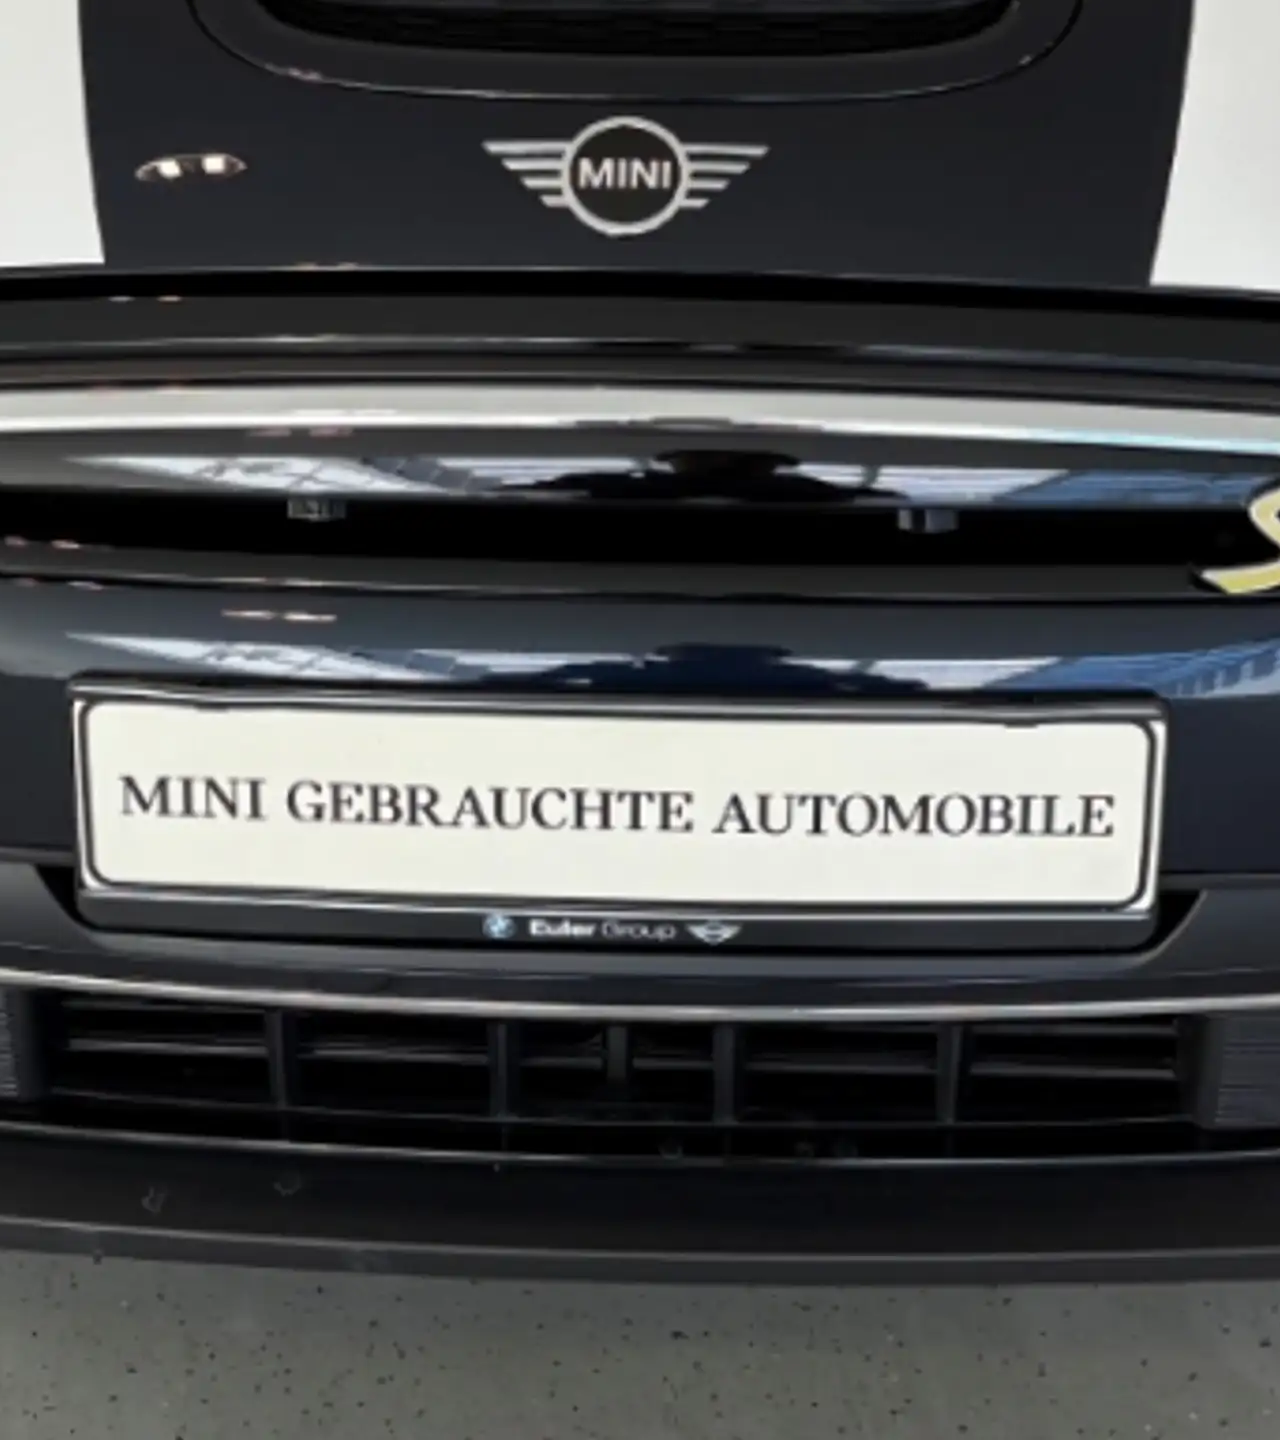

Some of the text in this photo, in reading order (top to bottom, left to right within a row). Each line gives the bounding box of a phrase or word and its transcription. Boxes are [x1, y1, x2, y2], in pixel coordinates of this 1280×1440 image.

[578, 157, 671, 190] MINI
[120, 774, 1115, 838] MINI GEBRAUCHTE AUTOMOBILE
[528, 918, 676, 941] Euler Group
